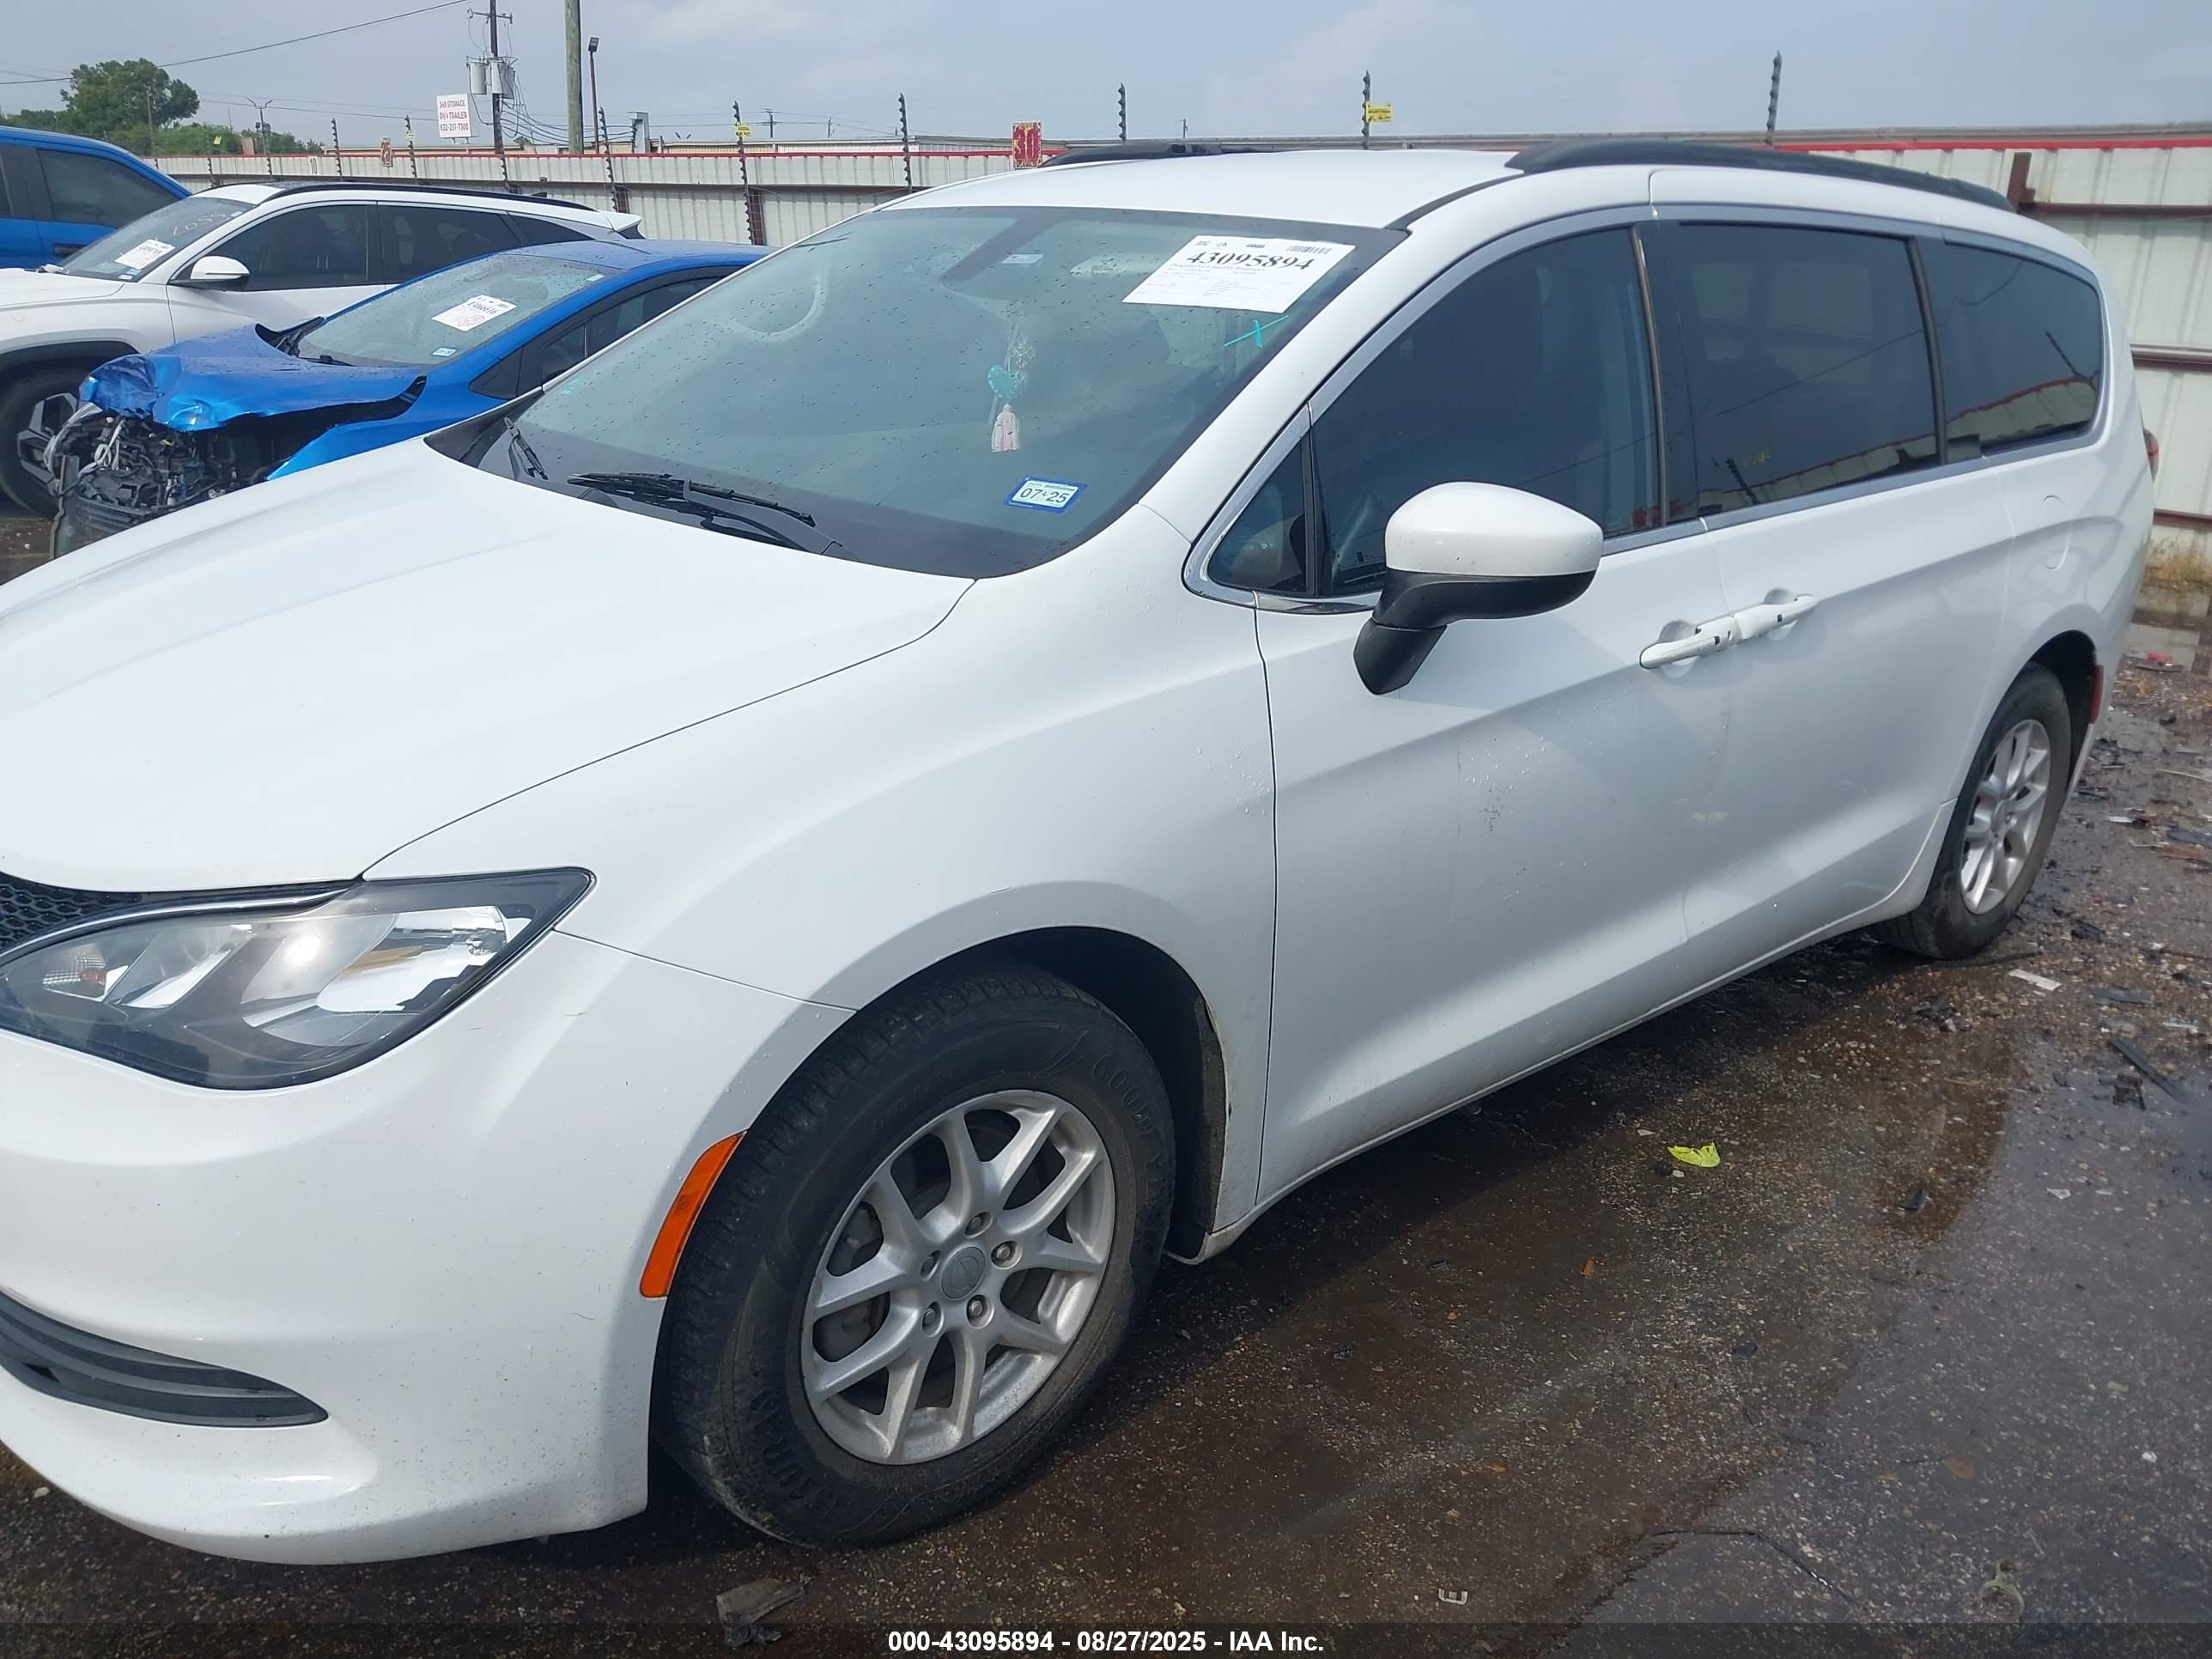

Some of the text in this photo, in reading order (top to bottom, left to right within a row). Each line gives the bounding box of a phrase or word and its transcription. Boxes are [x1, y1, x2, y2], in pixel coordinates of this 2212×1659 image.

[449, 111, 468, 119] TRAILER
[1014, 128, 1039, 161] 30
[1187, 251, 1316, 270] 43095894
[1020, 488, 1071, 503] 07 25
